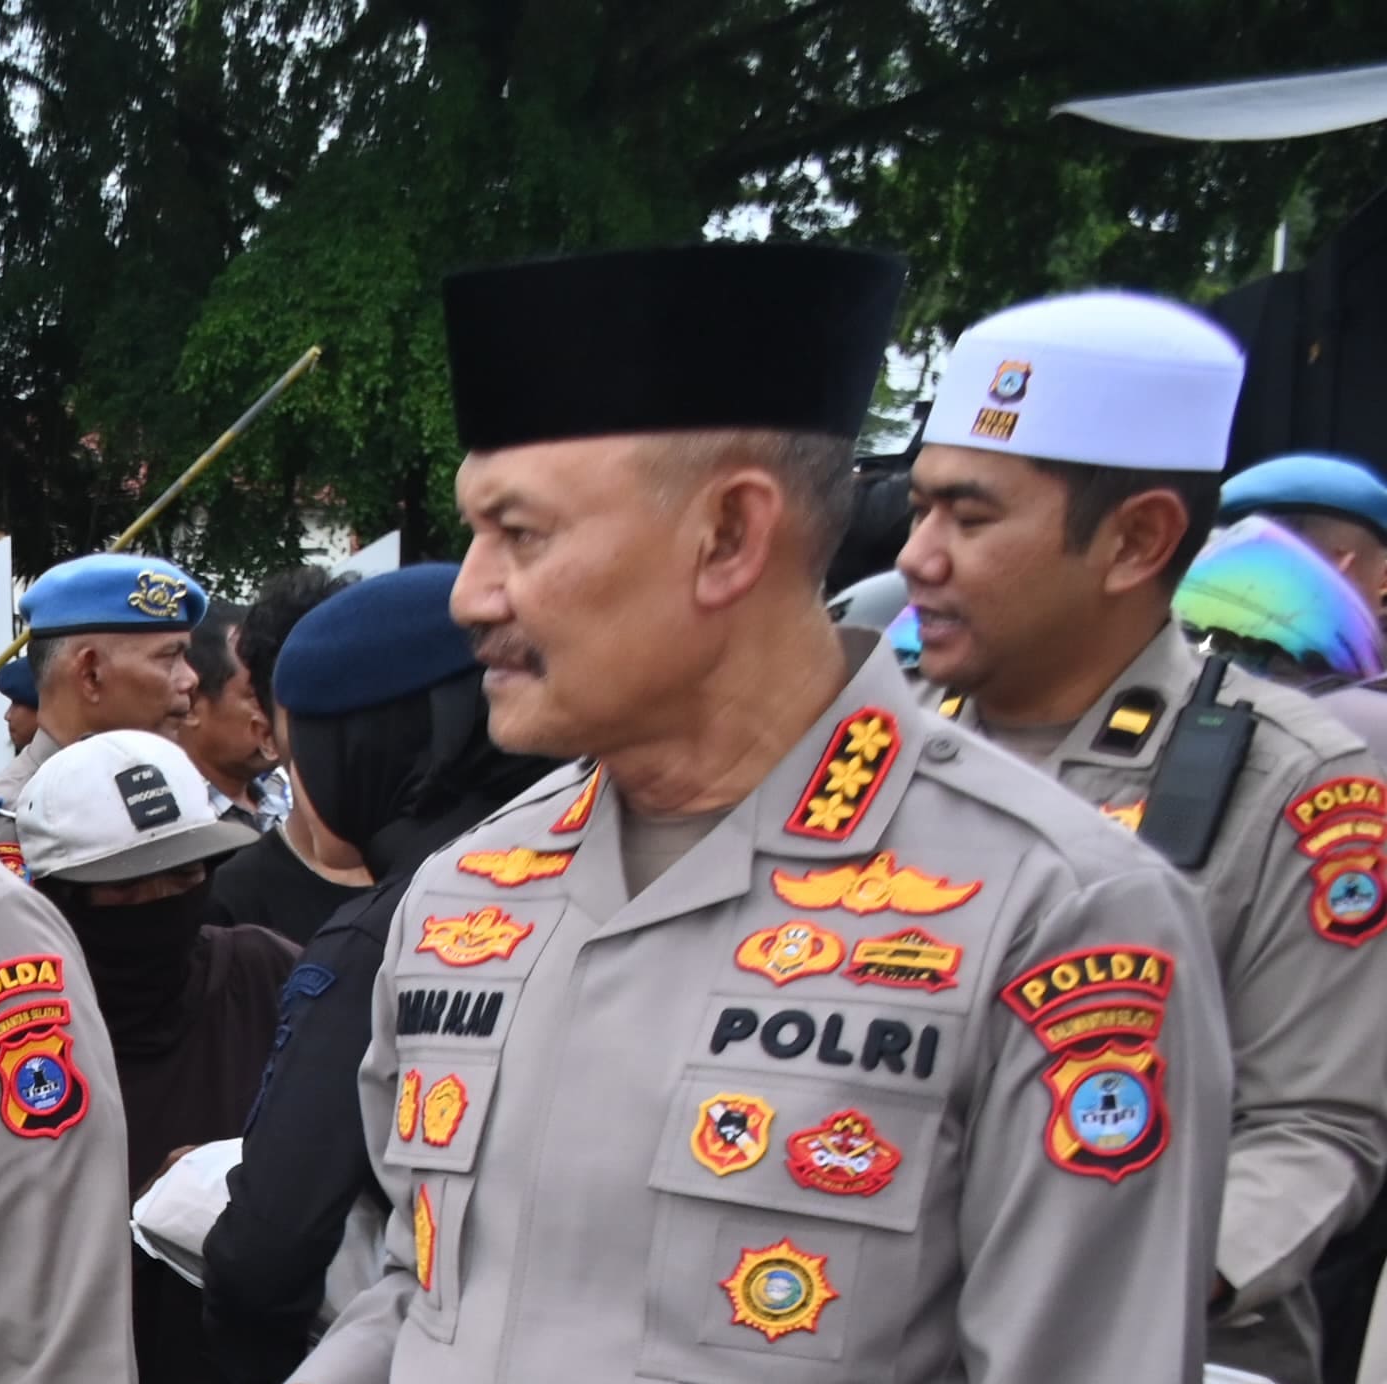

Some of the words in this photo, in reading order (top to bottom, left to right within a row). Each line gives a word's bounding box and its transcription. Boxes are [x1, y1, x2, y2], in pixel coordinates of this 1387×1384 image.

[1295, 783, 1380, 825] POLDA
[1021, 953, 1160, 1009] POLDA
[711, 1006, 938, 1080] POLRI
